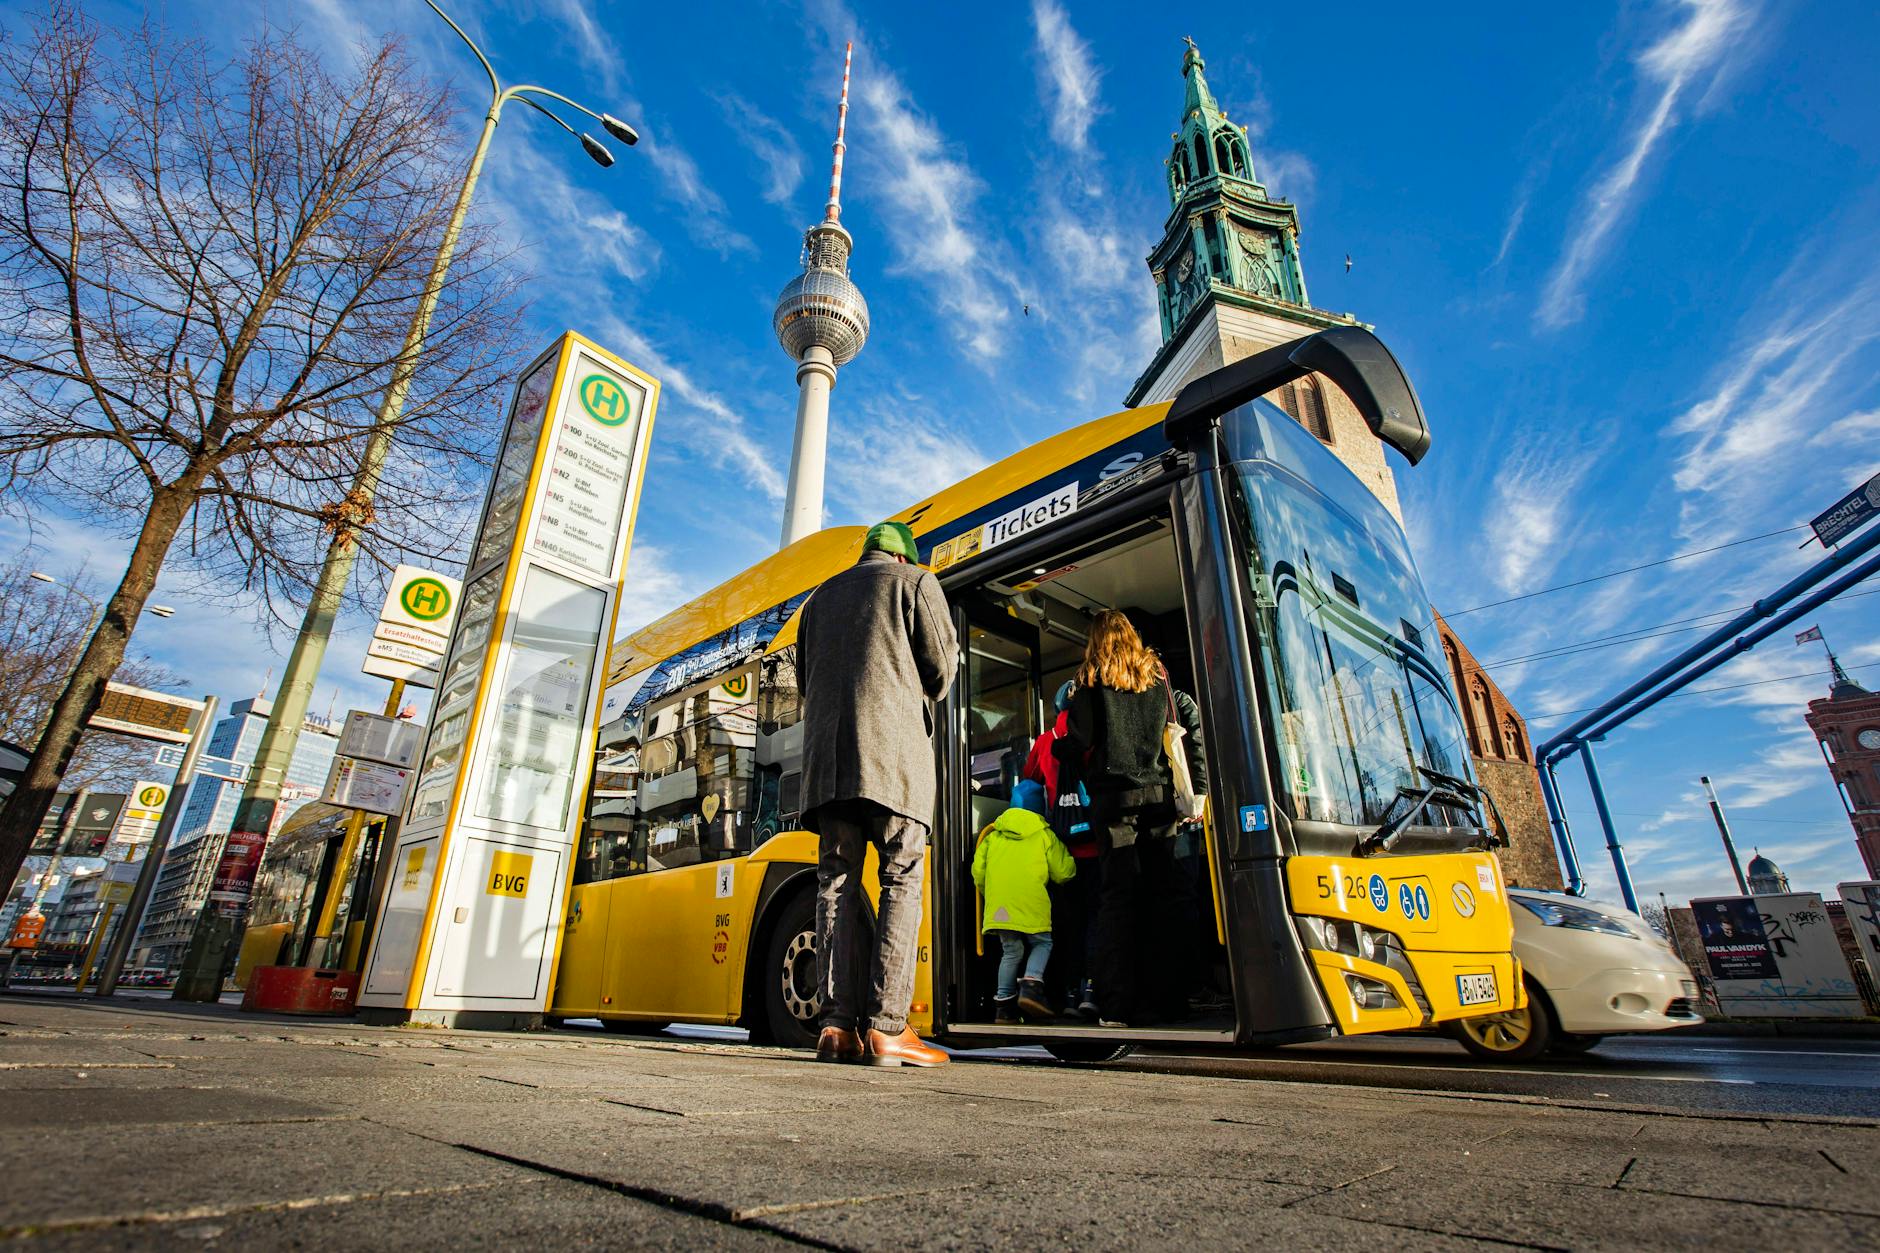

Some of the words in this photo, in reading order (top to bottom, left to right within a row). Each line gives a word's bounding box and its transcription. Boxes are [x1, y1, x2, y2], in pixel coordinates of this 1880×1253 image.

[592, 383, 620, 418] H
[570, 426, 582, 437] 100
[563, 448, 578, 460] 200
[558, 470, 570, 480] N2
[1099, 469, 1143, 494] SOLARIS
[552, 492, 565, 503] N5
[574, 483, 599, 498] Ruhleben
[547, 515, 559, 526] N8
[568, 506, 607, 526] Hauptbahnhof
[989, 493, 1071, 544] Tickets
[1815, 496, 1867, 533] BRECHTEL
[541, 540, 558, 552] N40
[563, 529, 604, 550] Hermannstraße
[413, 586, 440, 612] H
[384, 627, 443, 647] Ersatzhaltestelle
[666, 663, 687, 692] 200
[699, 642, 738, 668] Zoologischer
[493, 873, 525, 893] BVG
[715, 913, 730, 928] BVG
[714, 942, 727, 953] VBB
[1705, 945, 1729, 953] PAUL
[1728, 944, 1746, 952] VAN
